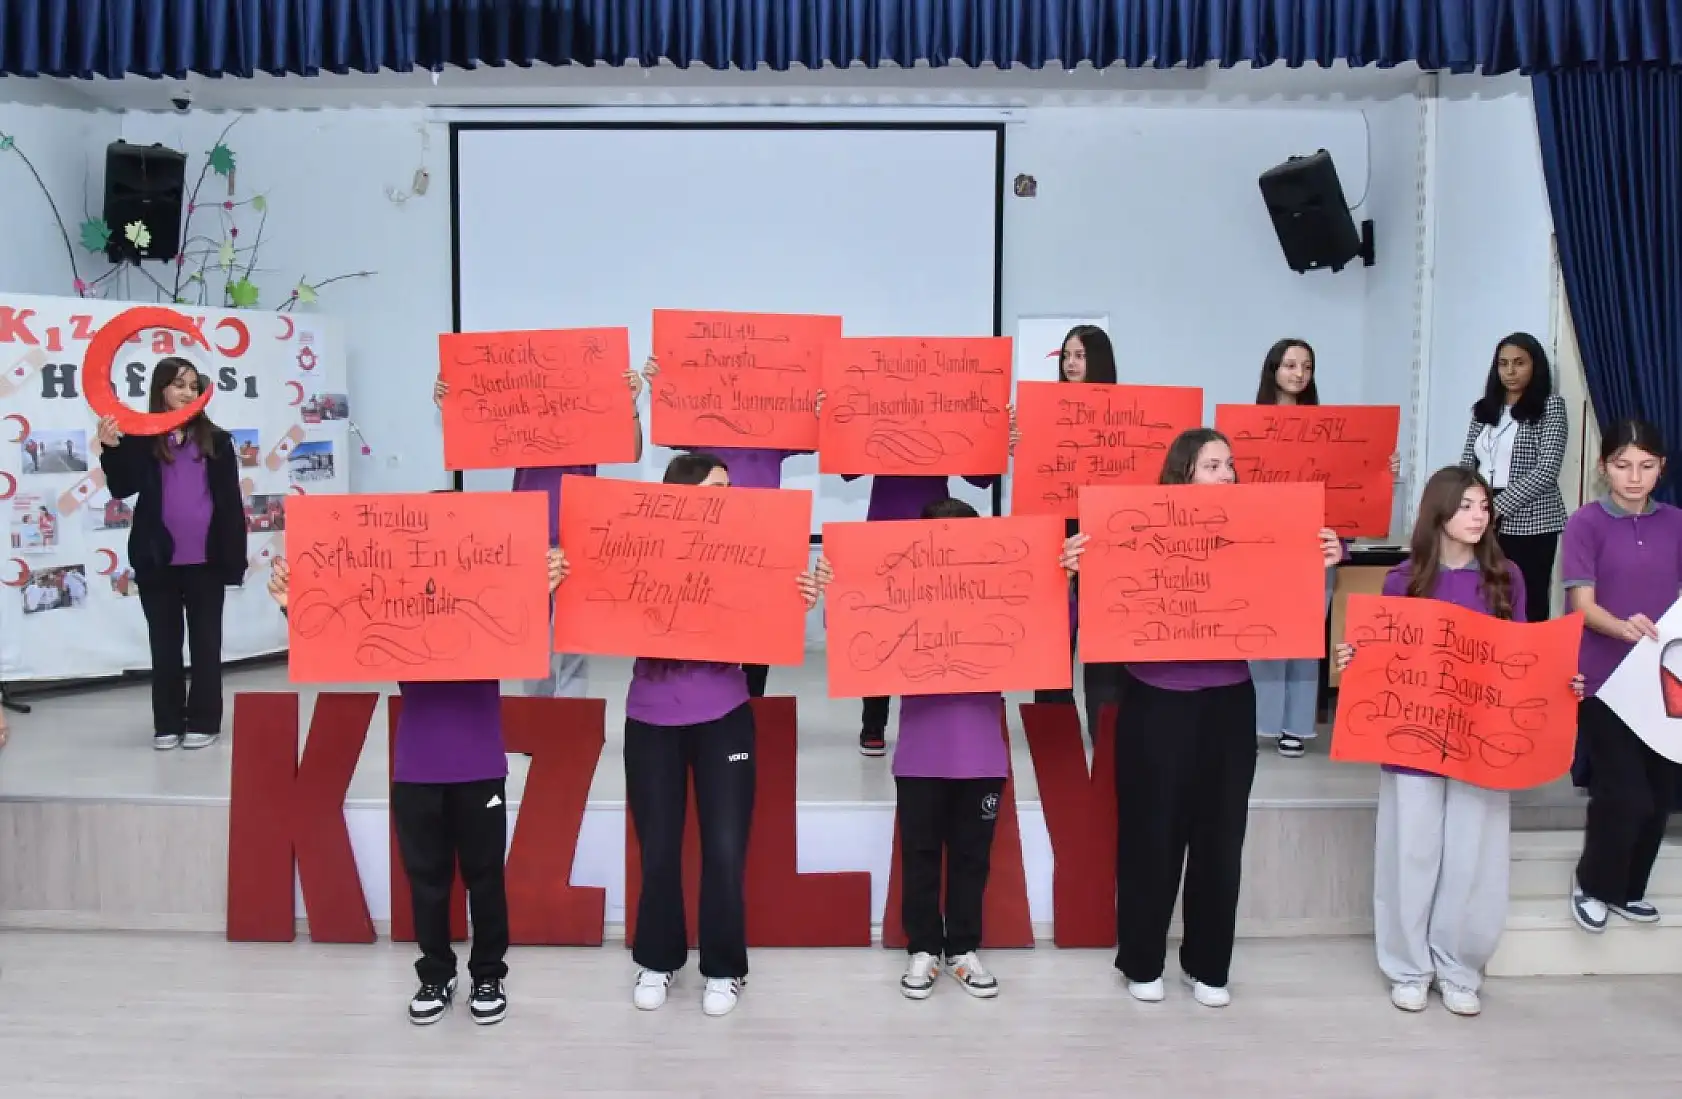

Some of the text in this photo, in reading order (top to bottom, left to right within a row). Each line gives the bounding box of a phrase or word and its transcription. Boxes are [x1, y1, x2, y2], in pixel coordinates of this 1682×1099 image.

[1103, 397, 1147, 427] damla
[296, 532, 522, 579] Şefkatin En Güzel
